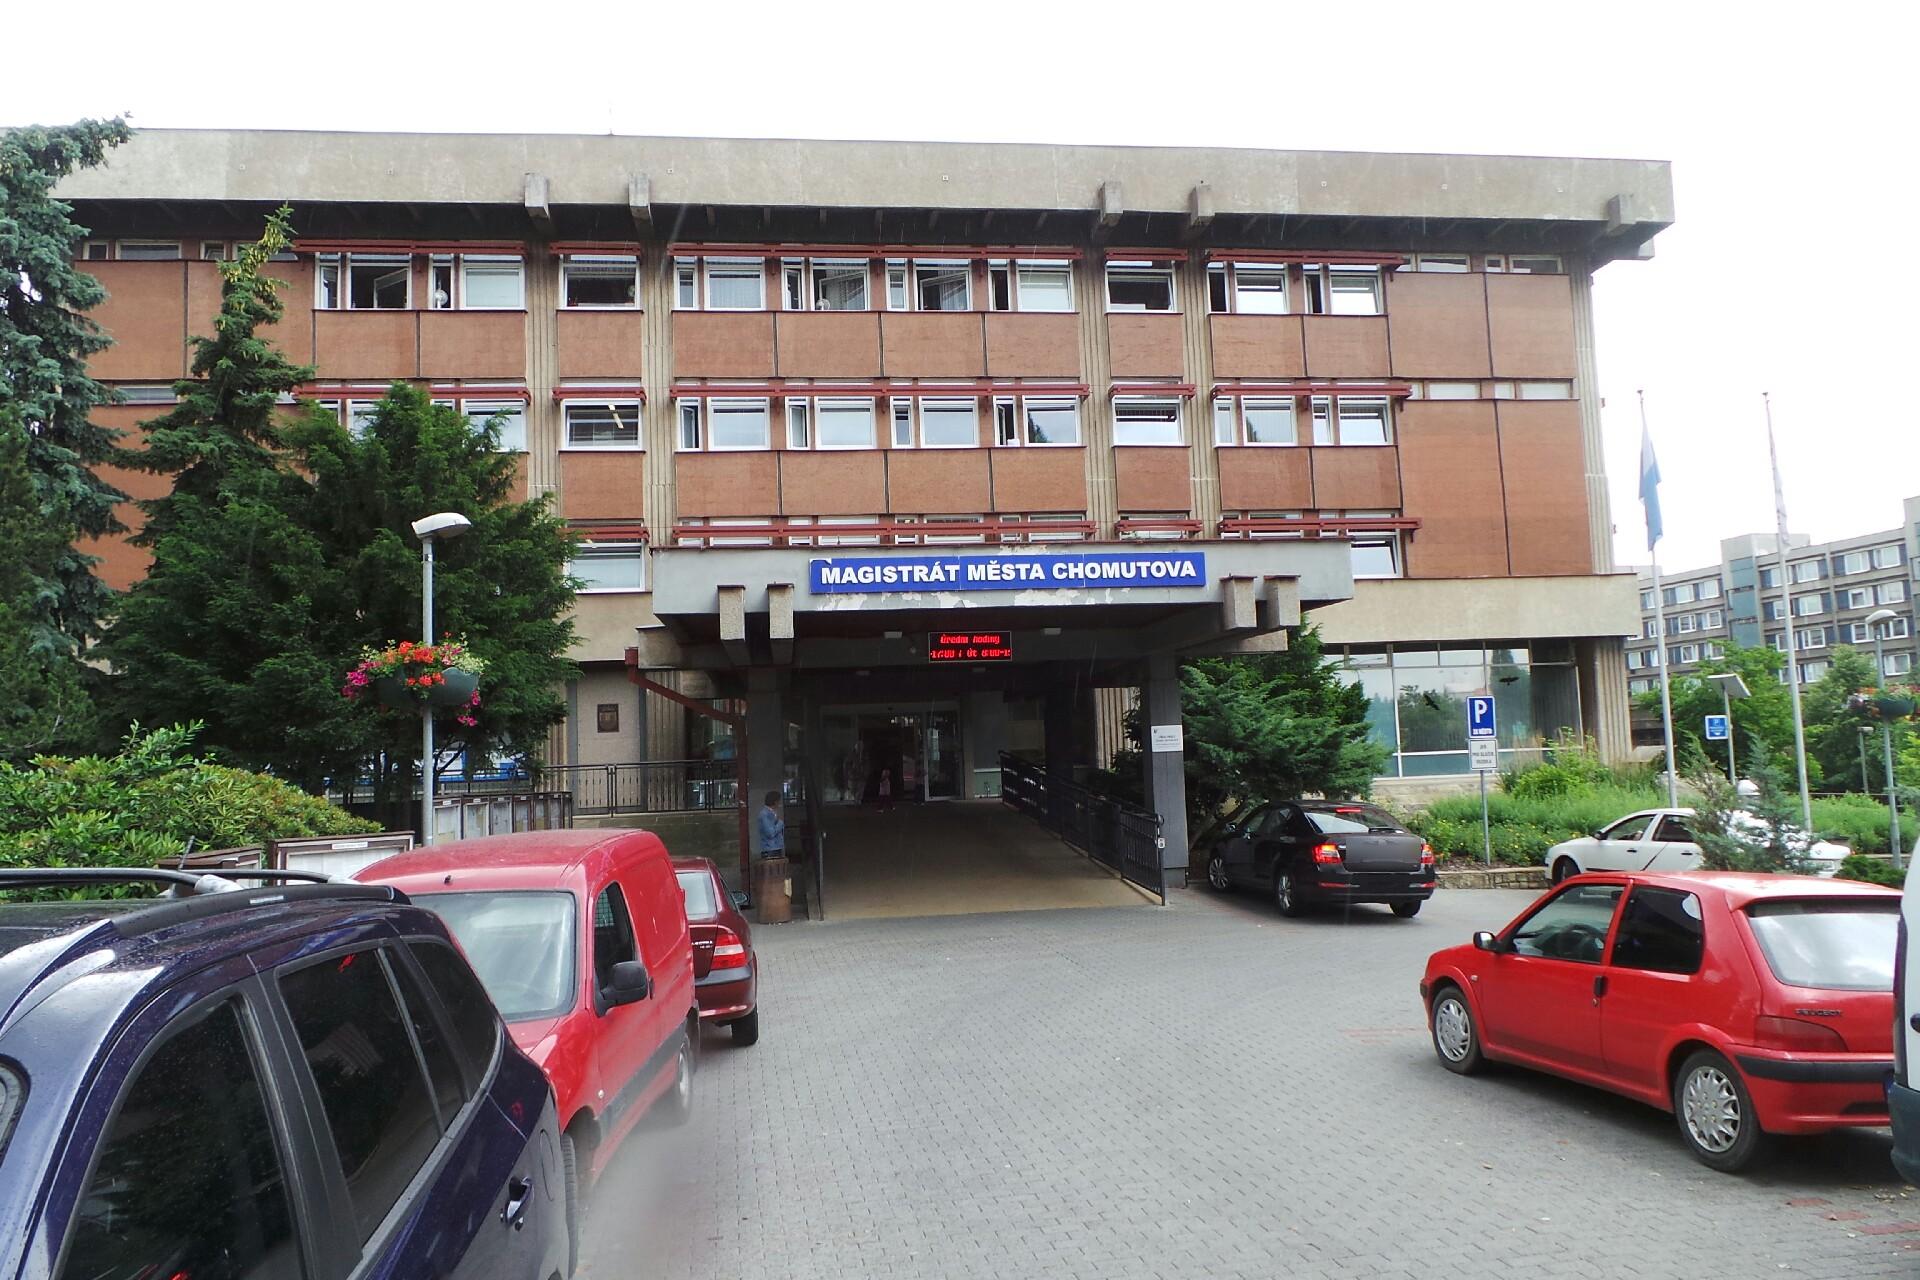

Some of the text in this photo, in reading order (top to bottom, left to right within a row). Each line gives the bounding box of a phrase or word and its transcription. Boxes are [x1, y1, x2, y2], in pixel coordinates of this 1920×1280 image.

[821, 560, 1197, 584] MAGISTRÁT MĚSTA CHOMUTOVA
[1474, 699, 1488, 724] P
